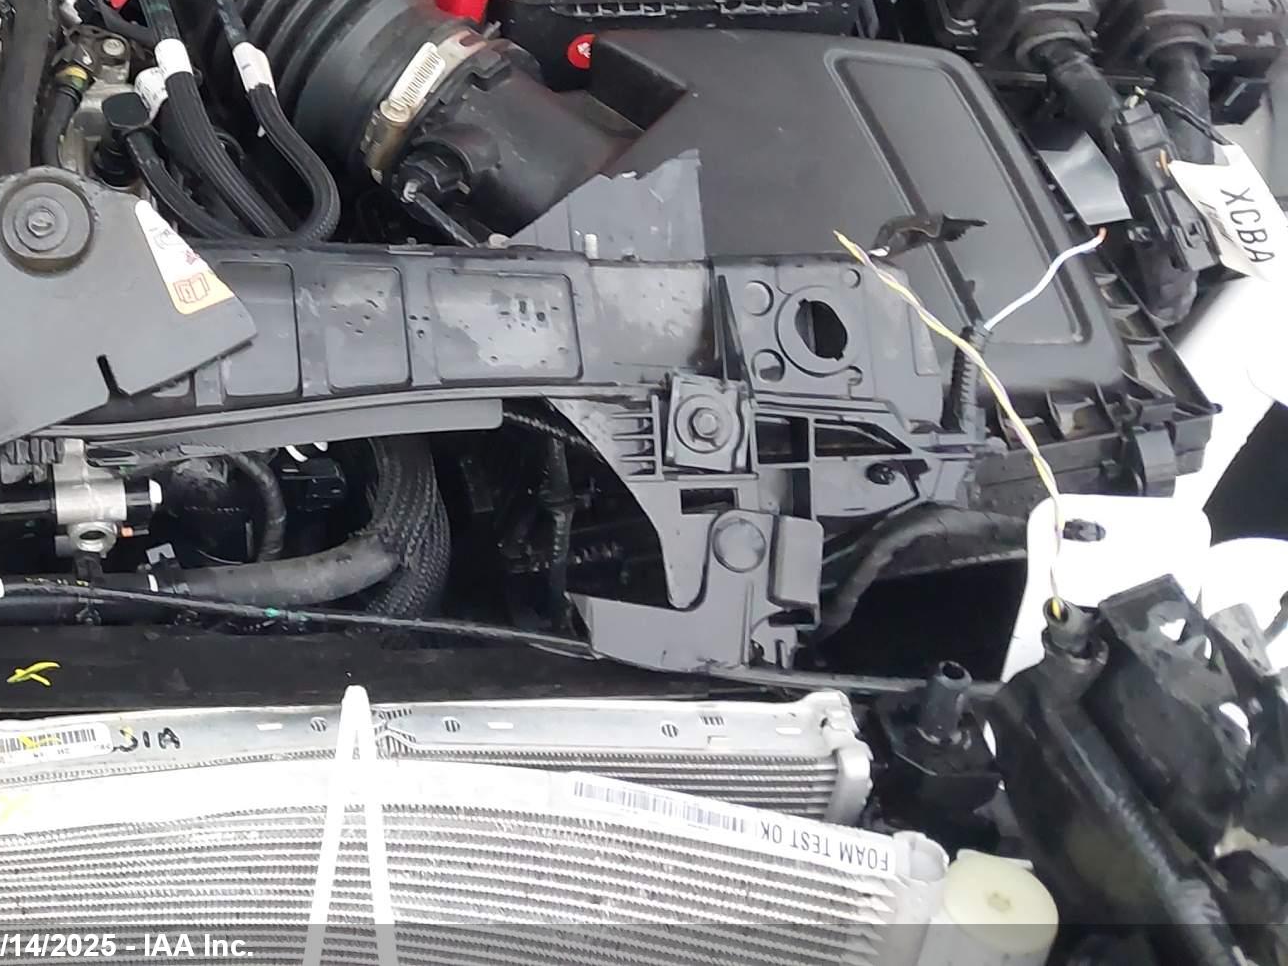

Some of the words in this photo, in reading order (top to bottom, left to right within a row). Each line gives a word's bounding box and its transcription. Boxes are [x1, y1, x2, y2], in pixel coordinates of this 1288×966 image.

[1219, 186, 1275, 263] XCBA
[760, 820, 783, 845] OK
[790, 829, 831, 857] TEST
[839, 841, 889, 872] FOAM
